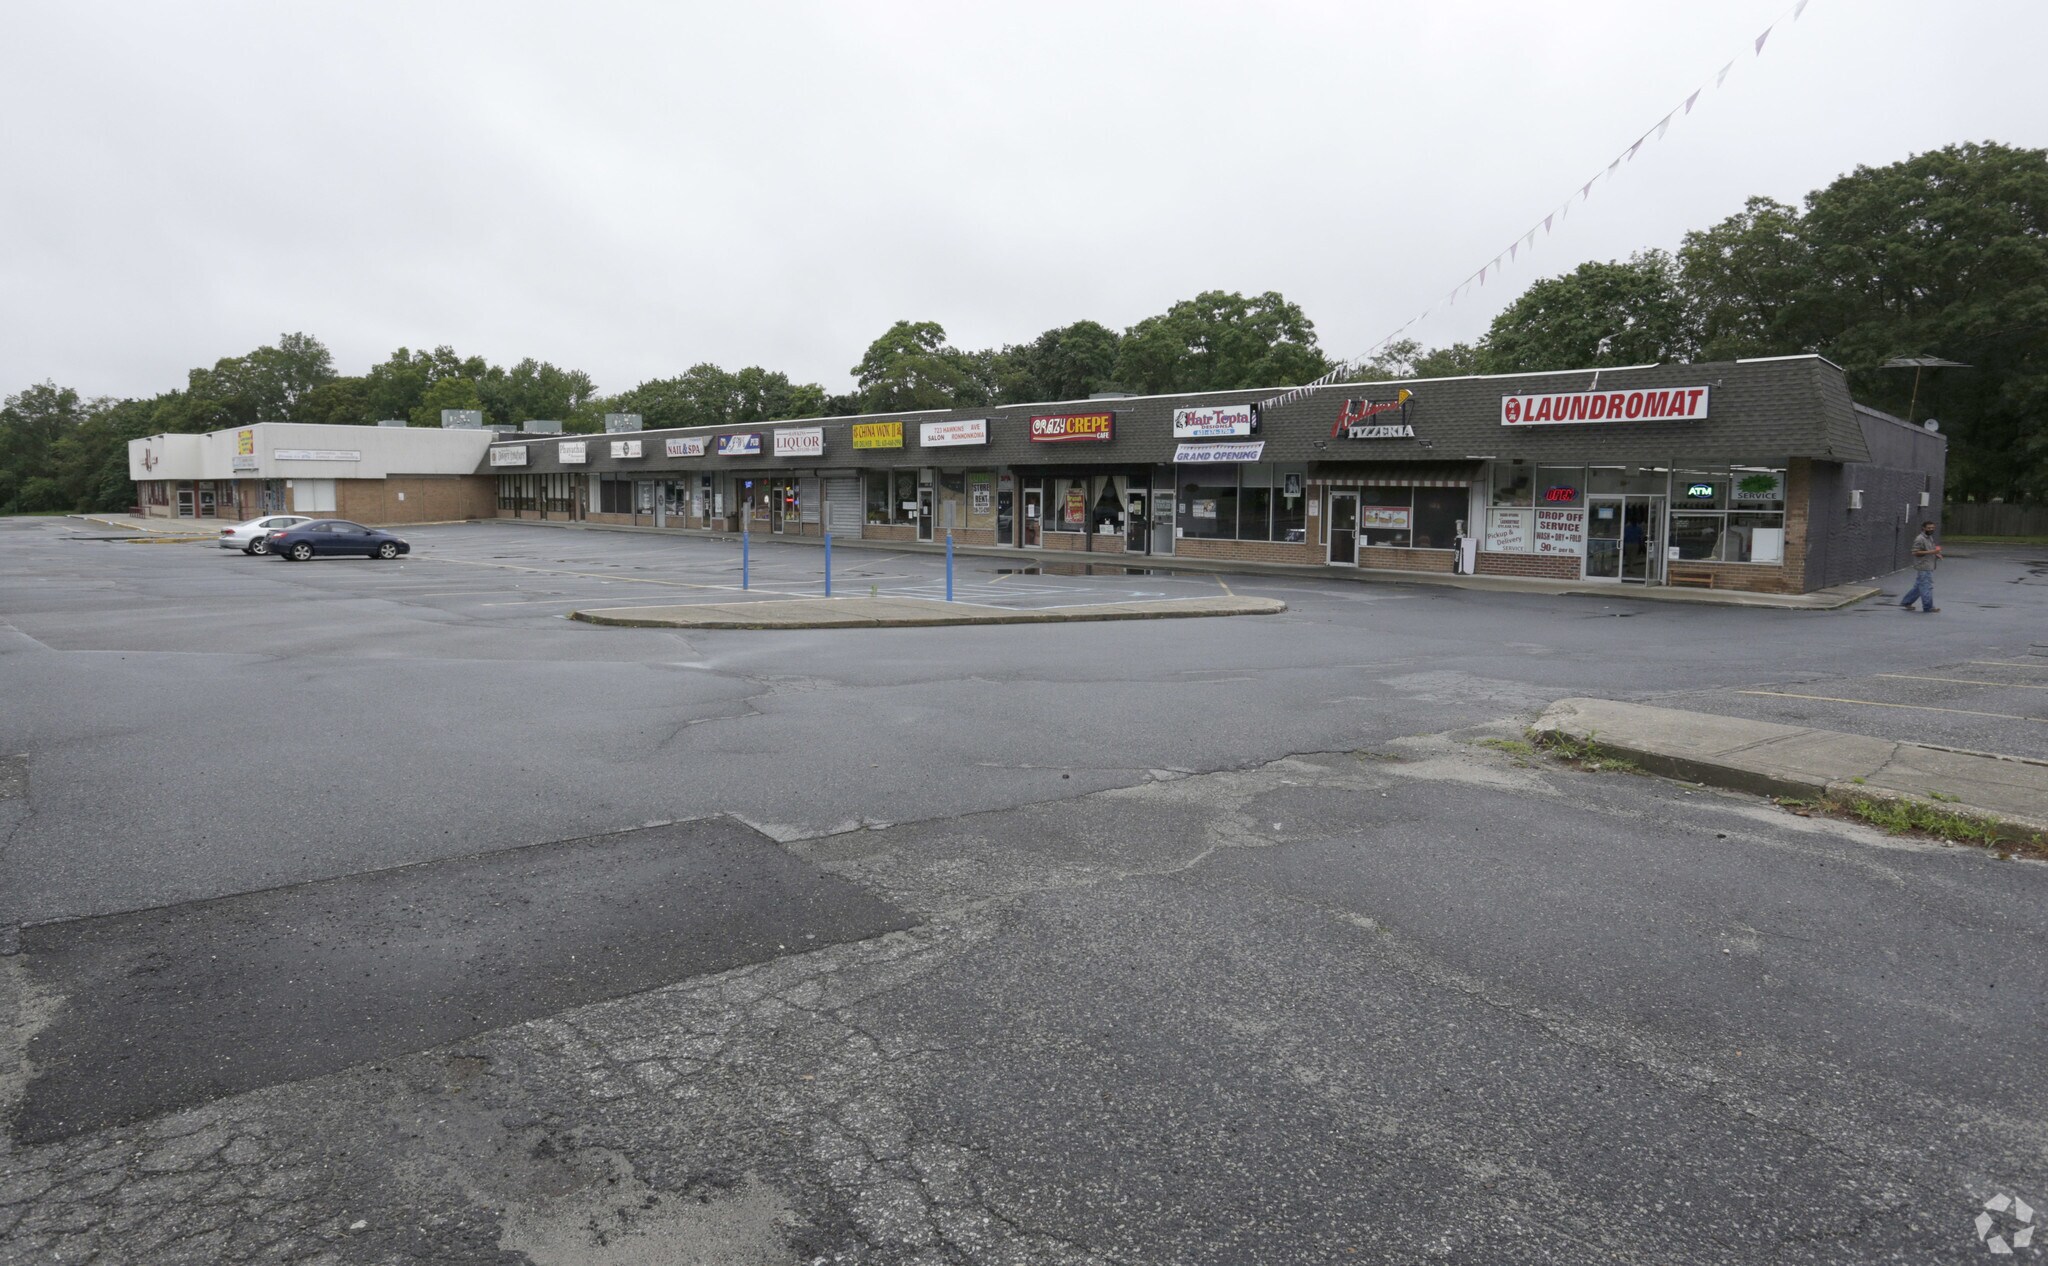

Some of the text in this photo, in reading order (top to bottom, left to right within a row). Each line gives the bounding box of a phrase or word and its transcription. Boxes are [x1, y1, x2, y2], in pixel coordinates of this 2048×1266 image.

[1523, 389, 1704, 422] LAUNDROMAT
[1186, 409, 1250, 428] Hair Topia
[859, 425, 876, 438] CHINA
[876, 424, 890, 437] WOK
[943, 425, 964, 433] HAWKINS
[1032, 416, 1109, 435] CRAZY CREPE
[1347, 425, 1415, 438] PIZZERIA
[776, 436, 820, 450] LIQUOR
[667, 446, 682, 455] NAIL
[688, 445, 701, 454] SPA
[1176, 451, 1258, 461] GRAND OPENING
[1546, 488, 1575, 501] OPEN
[1688, 486, 1712, 496] ATM
[1538, 511, 1584, 522] DROP OFF
[1540, 521, 1580, 532] SERVICE
[1487, 530, 1508, 540] Pickup
[1536, 532, 1582, 542] WASH DRY FOLD
[1496, 536, 1522, 546] Delivery
